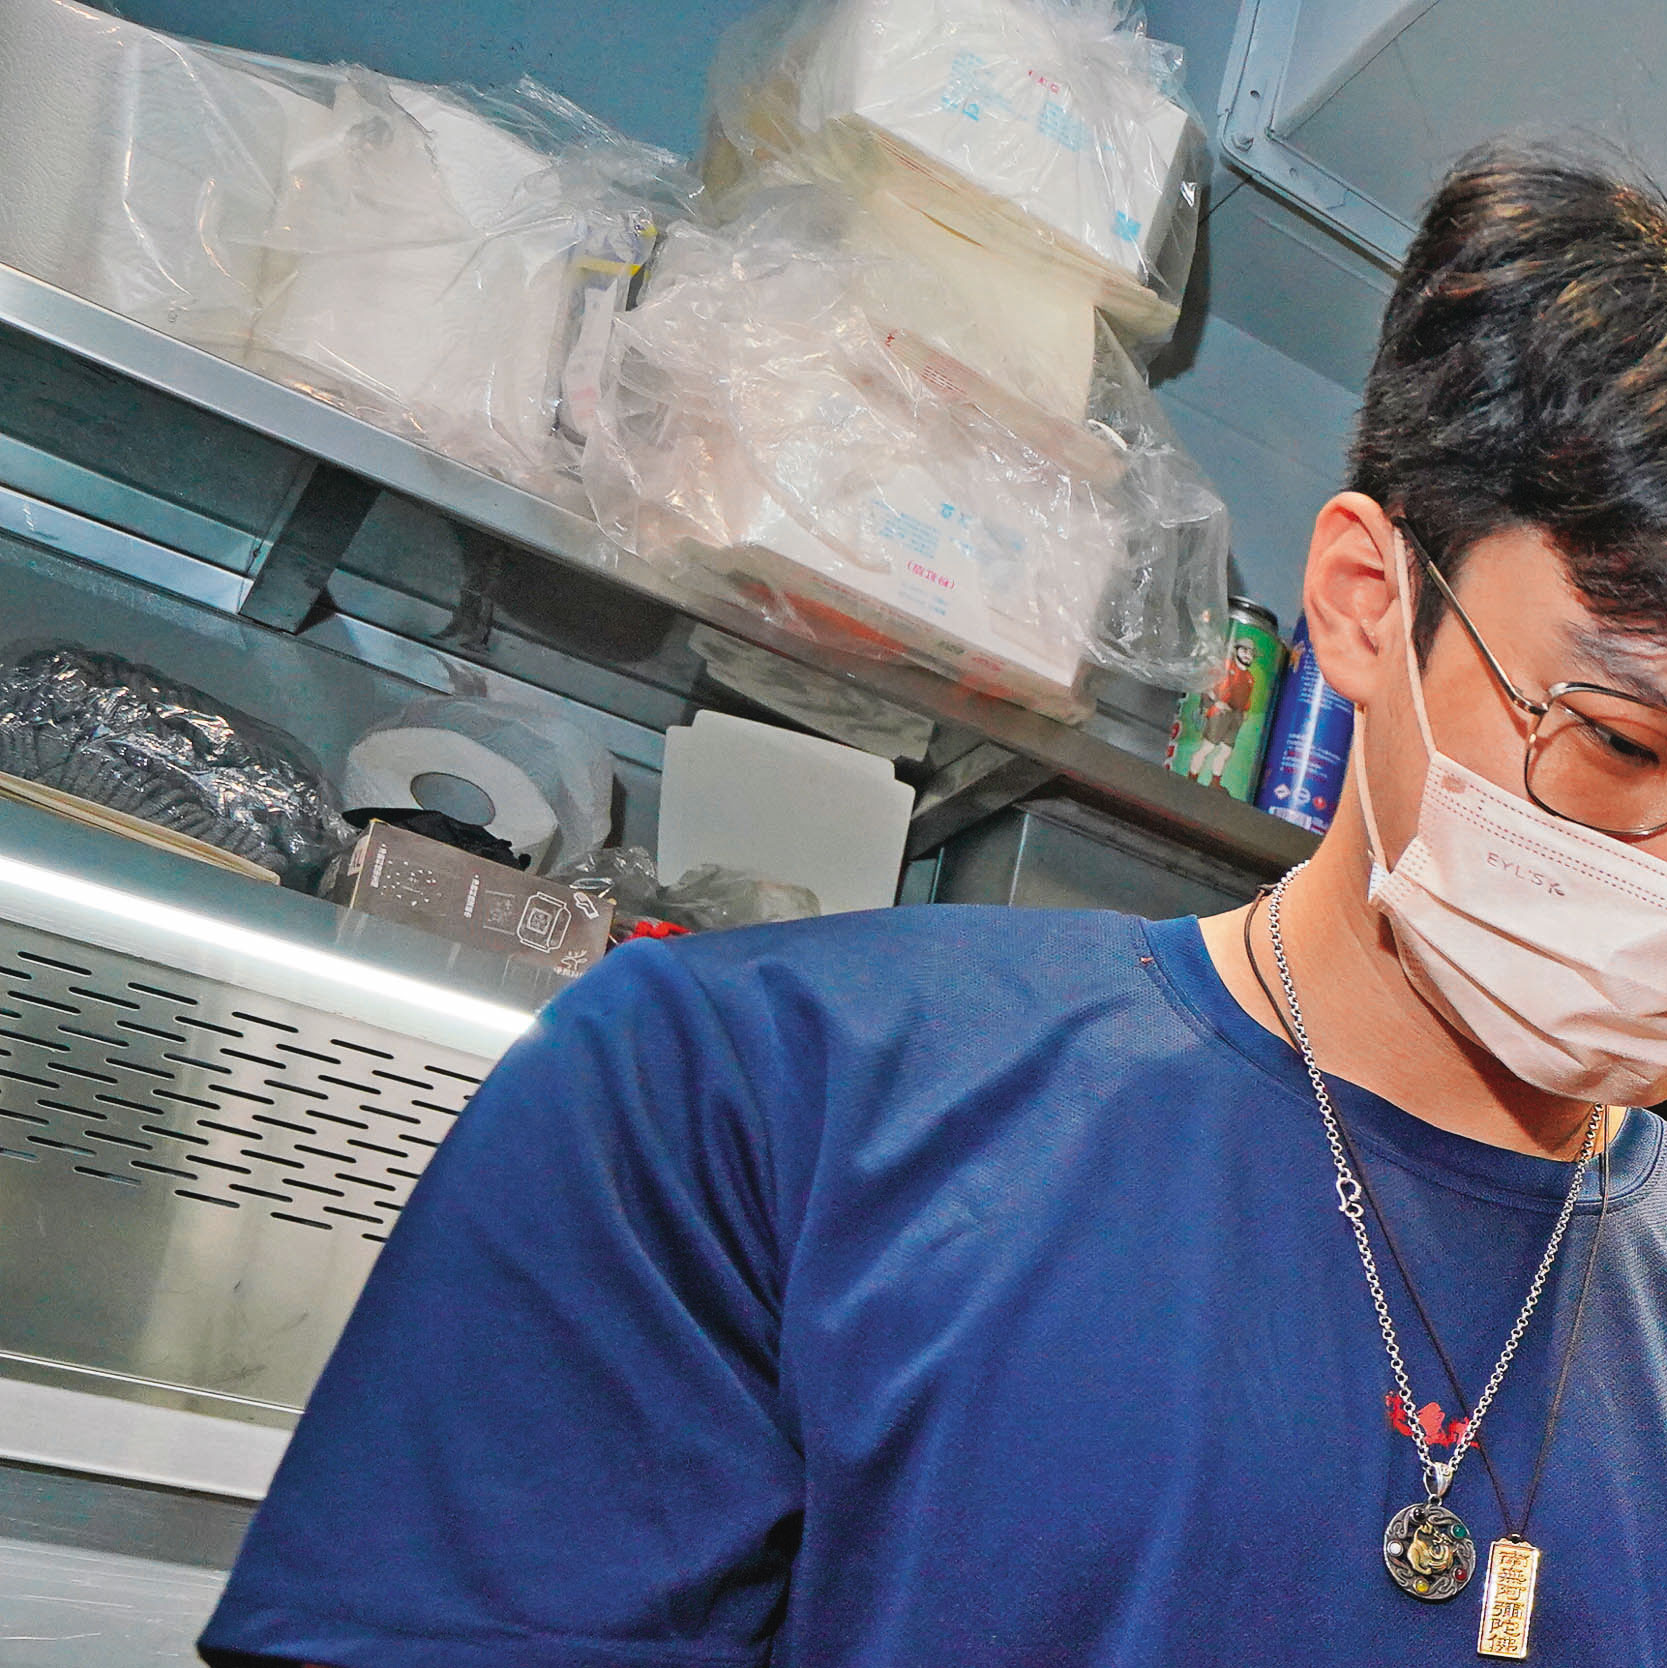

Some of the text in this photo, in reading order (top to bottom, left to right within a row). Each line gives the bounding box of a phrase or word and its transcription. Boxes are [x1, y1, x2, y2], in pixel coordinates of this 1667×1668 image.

[1487, 1550, 1531, 1653] 南無阿彌陀佛
